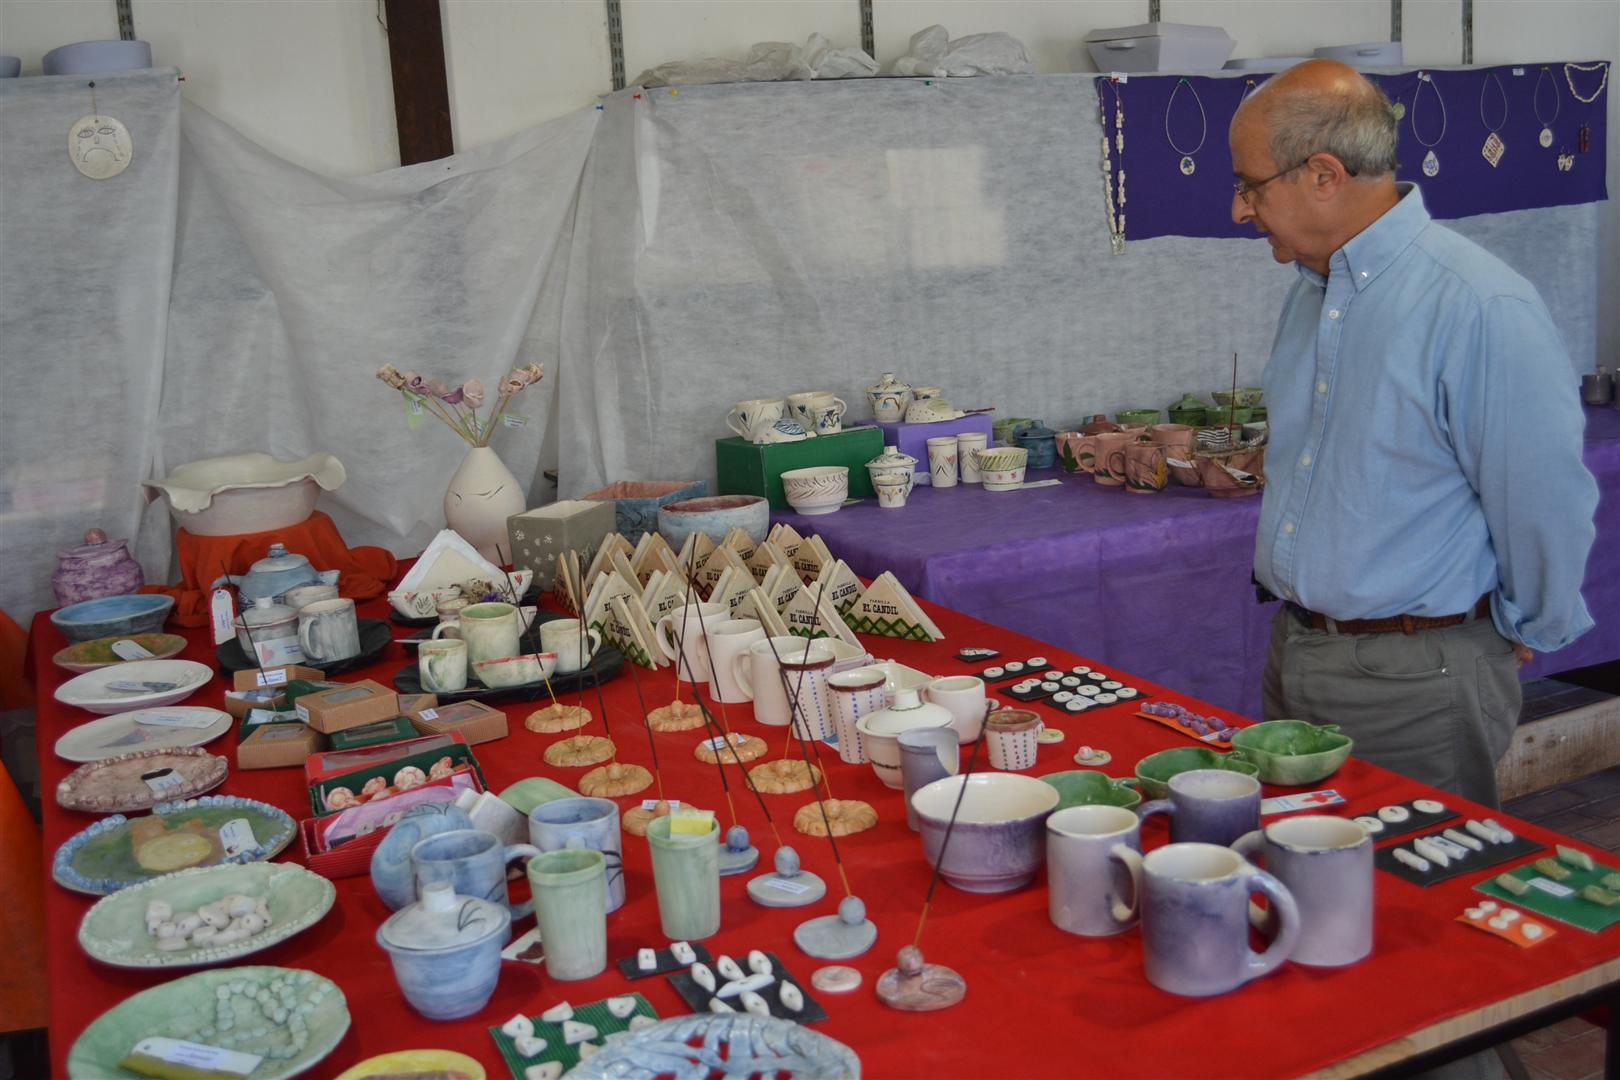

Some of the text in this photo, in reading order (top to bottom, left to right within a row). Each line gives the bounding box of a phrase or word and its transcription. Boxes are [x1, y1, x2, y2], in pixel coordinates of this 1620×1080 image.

[794, 561, 820, 573] EL CANDIL
[832, 583, 858, 600] EL CANDIL
[658, 601, 667, 612] EL
[730, 598, 737, 607] EL
[777, 597, 785, 606] EL
[862, 603, 899, 615] EL CANDIL
[790, 613, 797, 623] EL
